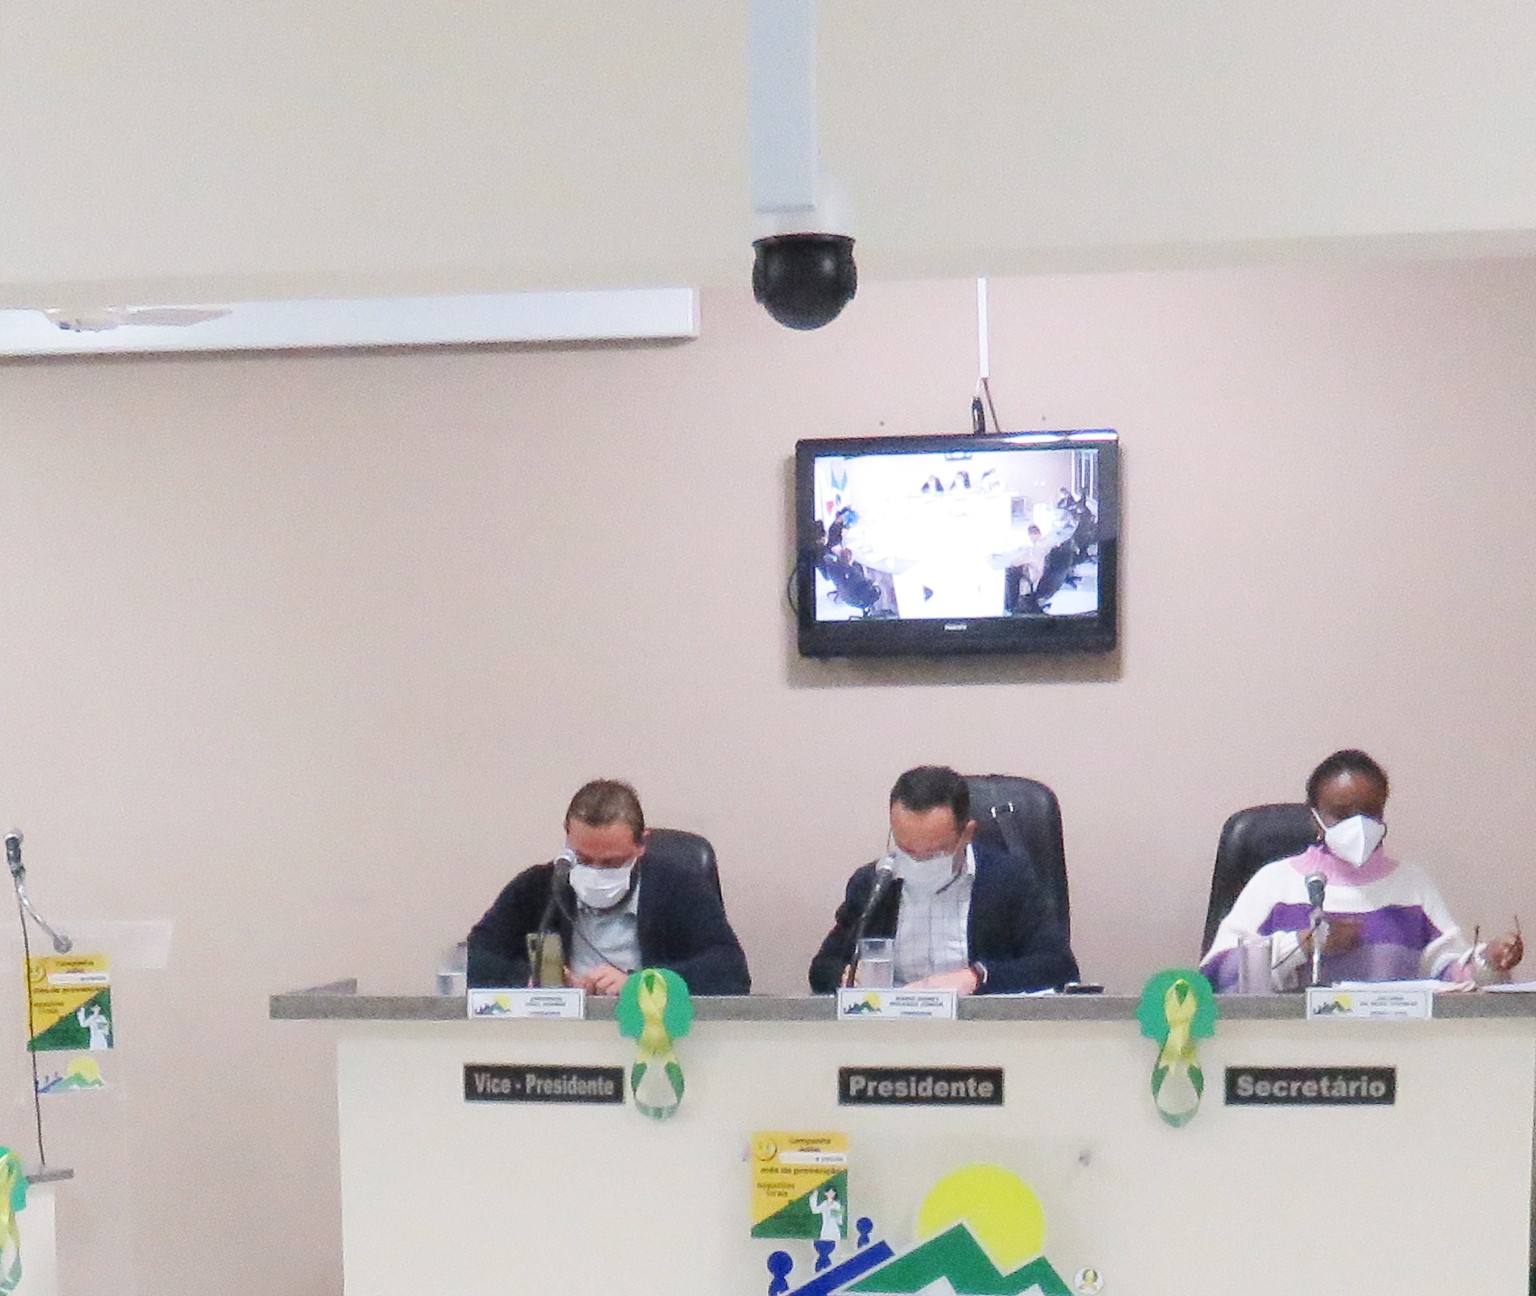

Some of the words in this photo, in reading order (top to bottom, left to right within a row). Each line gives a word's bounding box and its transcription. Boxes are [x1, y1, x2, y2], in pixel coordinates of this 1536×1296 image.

[474, 1072, 511, 1094] Vice
[525, 1073, 614, 1096] Presidente
[849, 1075, 994, 1098] Presidente
[1236, 1074, 1386, 1097] Secretário
